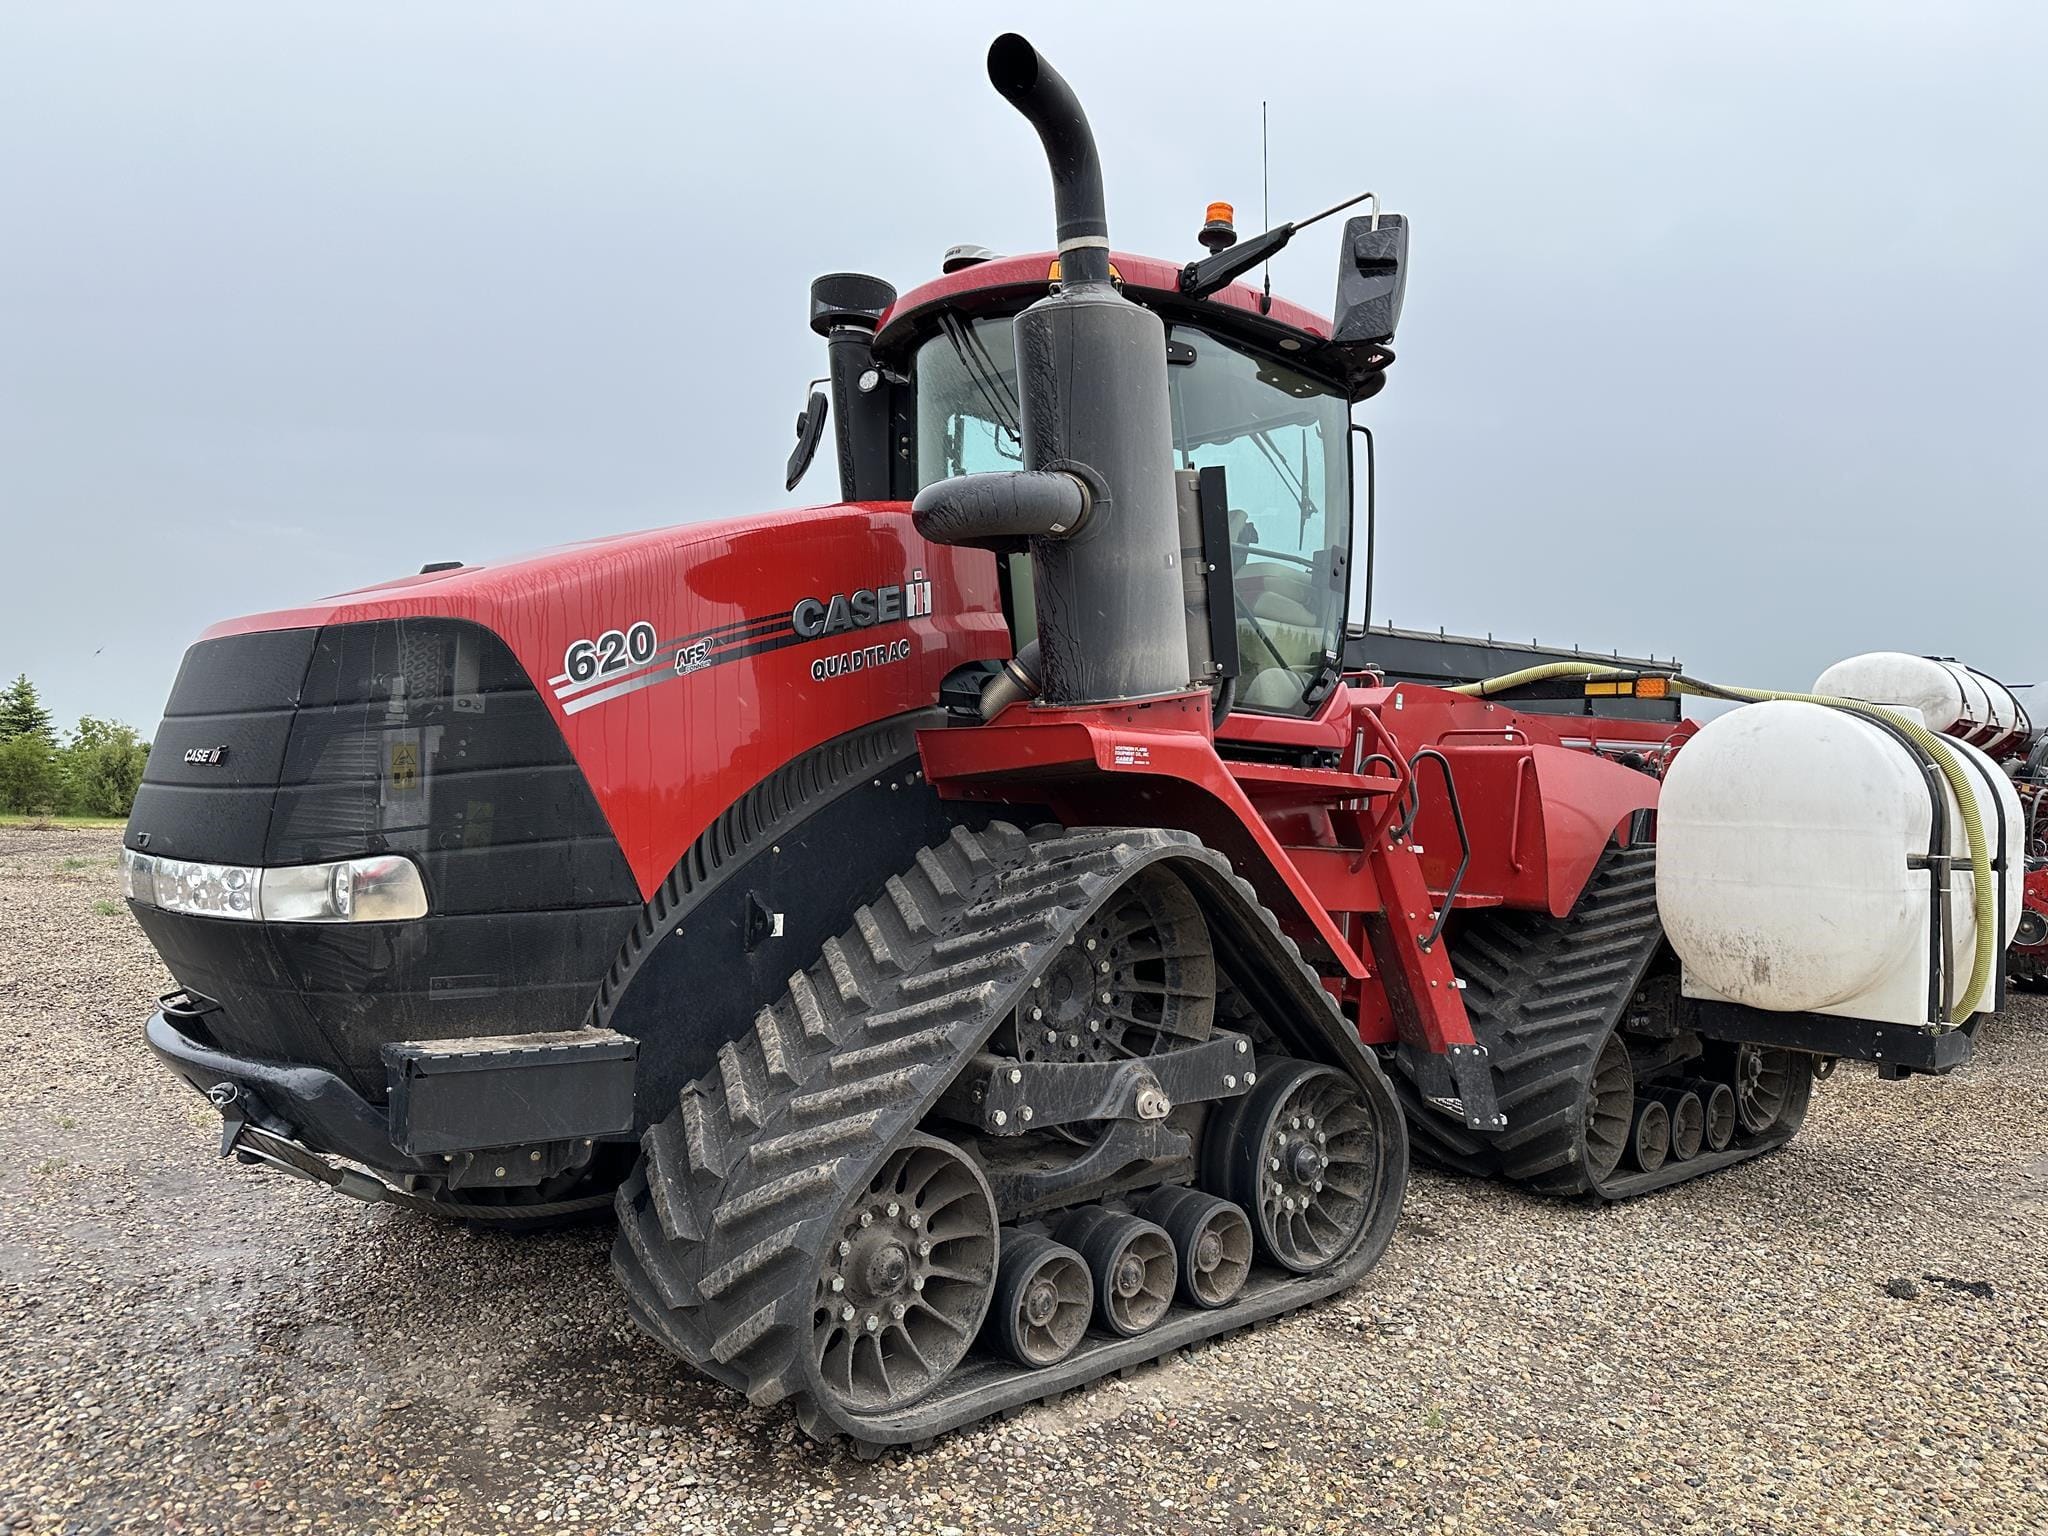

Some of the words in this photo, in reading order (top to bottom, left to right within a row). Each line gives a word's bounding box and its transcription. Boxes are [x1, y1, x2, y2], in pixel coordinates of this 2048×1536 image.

[792, 585, 900, 638] CASE
[565, 621, 657, 684] 620
[674, 642, 706, 669] AFS
[811, 638, 911, 682] QUADTRAC
[184, 749, 210, 762] CASE
